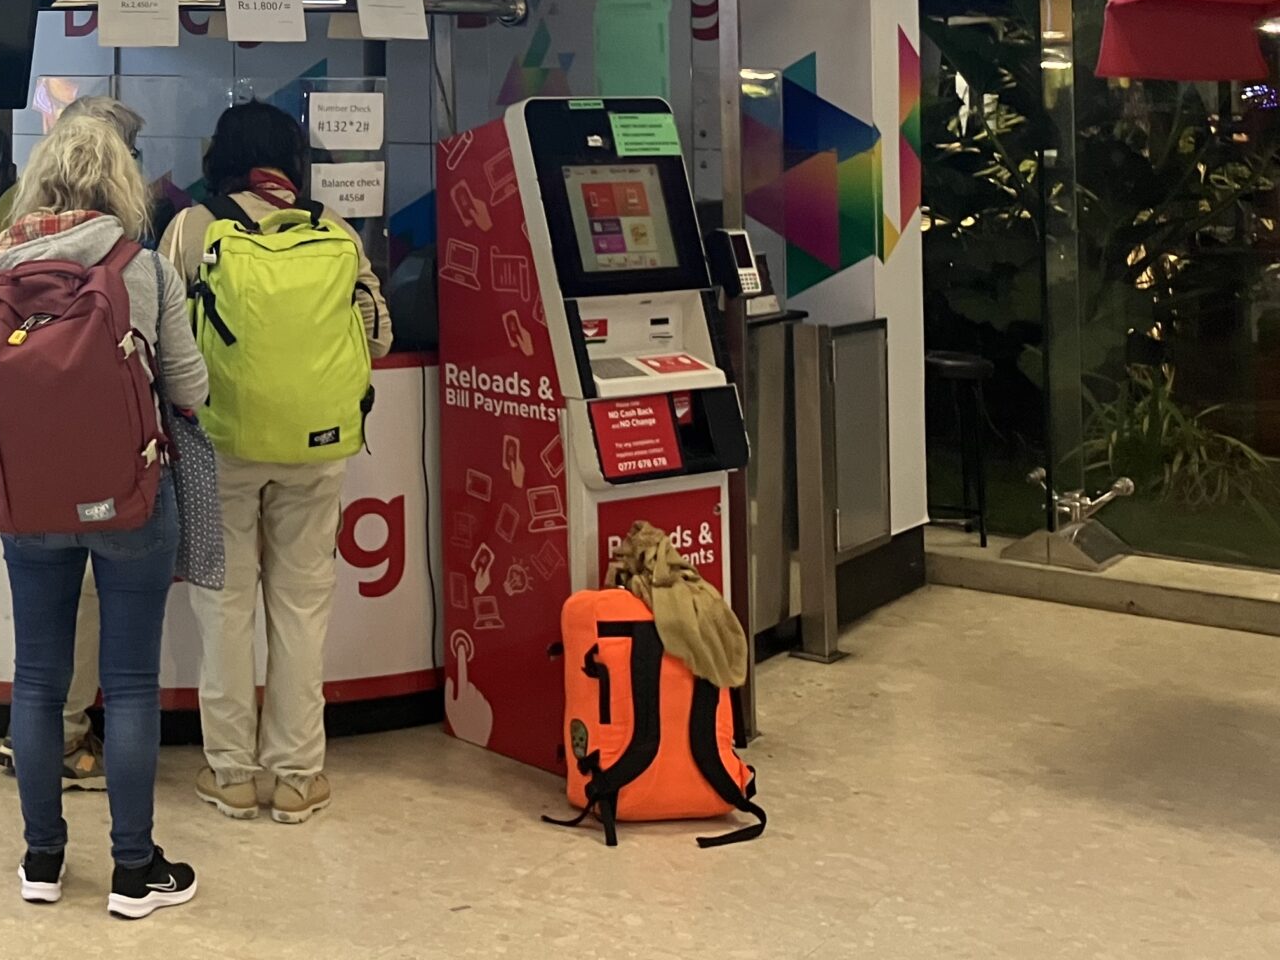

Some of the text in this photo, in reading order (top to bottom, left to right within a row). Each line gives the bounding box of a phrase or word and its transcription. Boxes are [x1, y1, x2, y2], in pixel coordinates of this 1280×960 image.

[318, 105, 371, 113] Number Check
[322, 179, 380, 188] Balance check
[445, 363, 554, 401] Reloads &
[446, 388, 556, 422] Bill Payments
[608, 407, 653, 419] NO Cash Back
[619, 420, 631, 428] NO
[631, 418, 656, 427] Change
[618, 460, 636, 472] 0777
[698, 522, 713, 545] &
